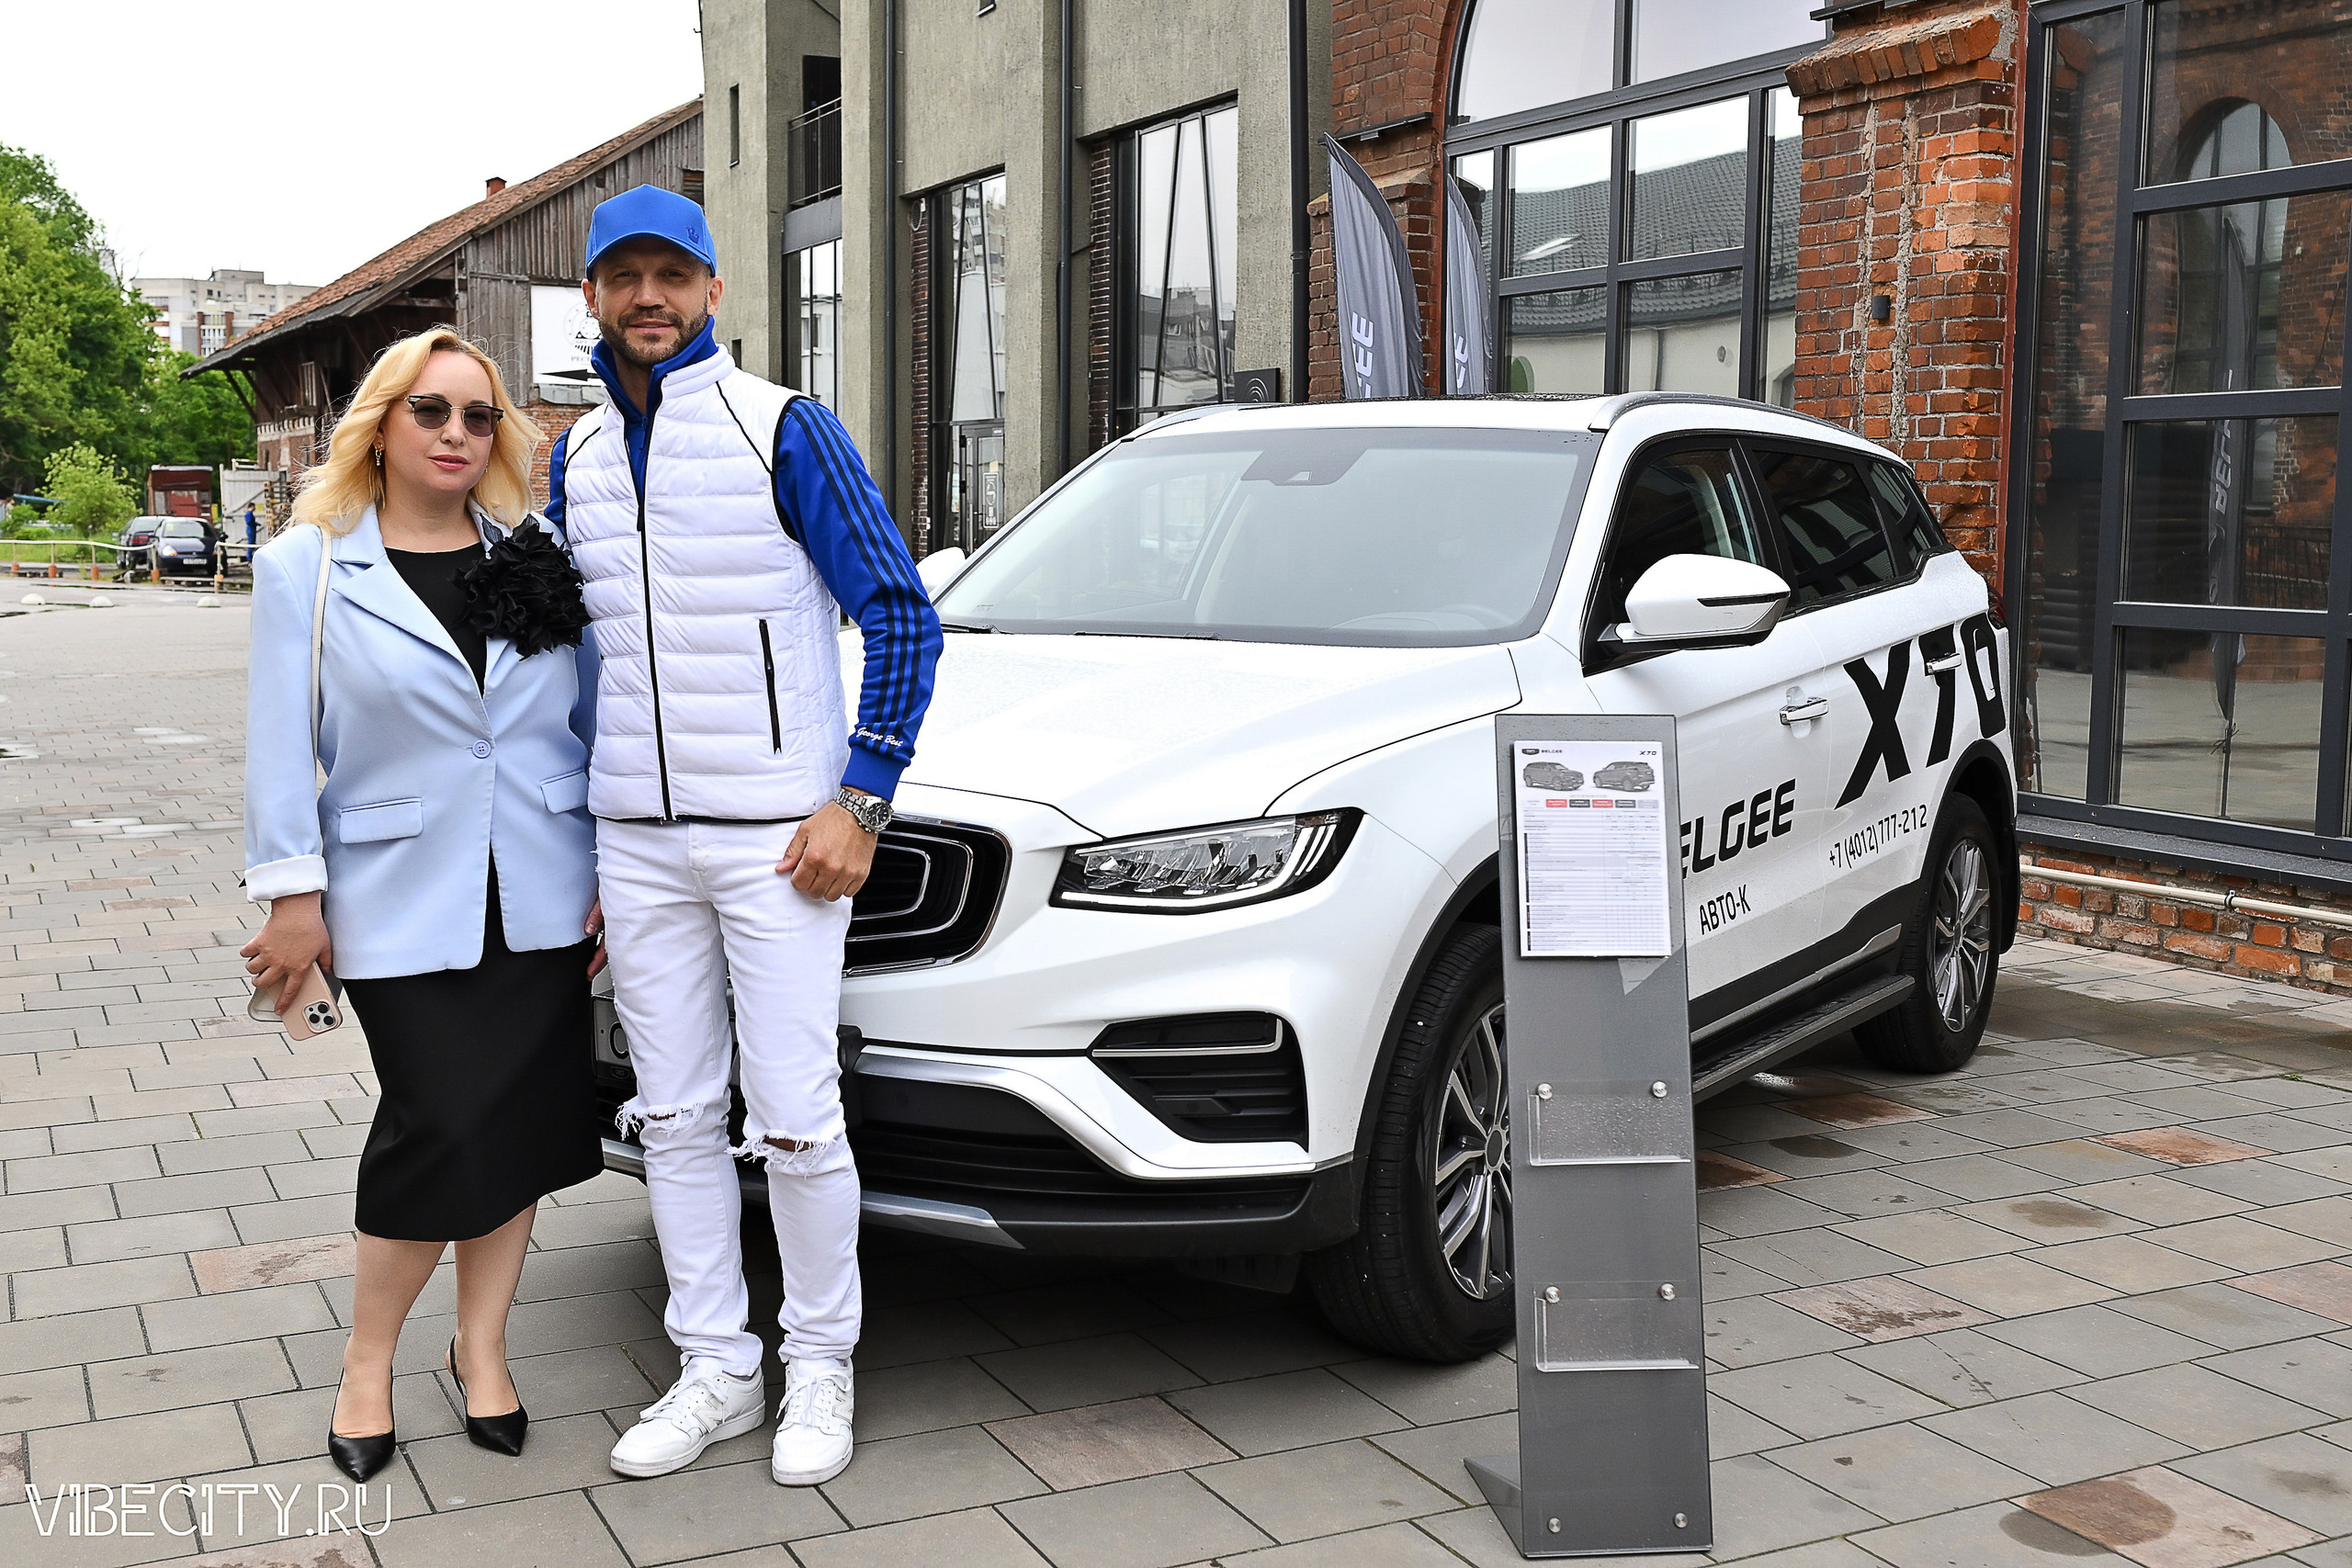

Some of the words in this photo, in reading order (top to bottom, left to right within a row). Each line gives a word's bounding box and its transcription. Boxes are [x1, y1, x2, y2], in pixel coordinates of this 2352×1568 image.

[856, 727, 883, 741] George
[885, 735, 903, 747] Best
[1834, 613, 2006, 810] X70
[1829, 842, 1841, 868] +7
[1844, 825, 1879, 869] (4012)
[1878, 804, 1928, 845] 777-212
[1700, 885, 1751, 935] АВТО-К
